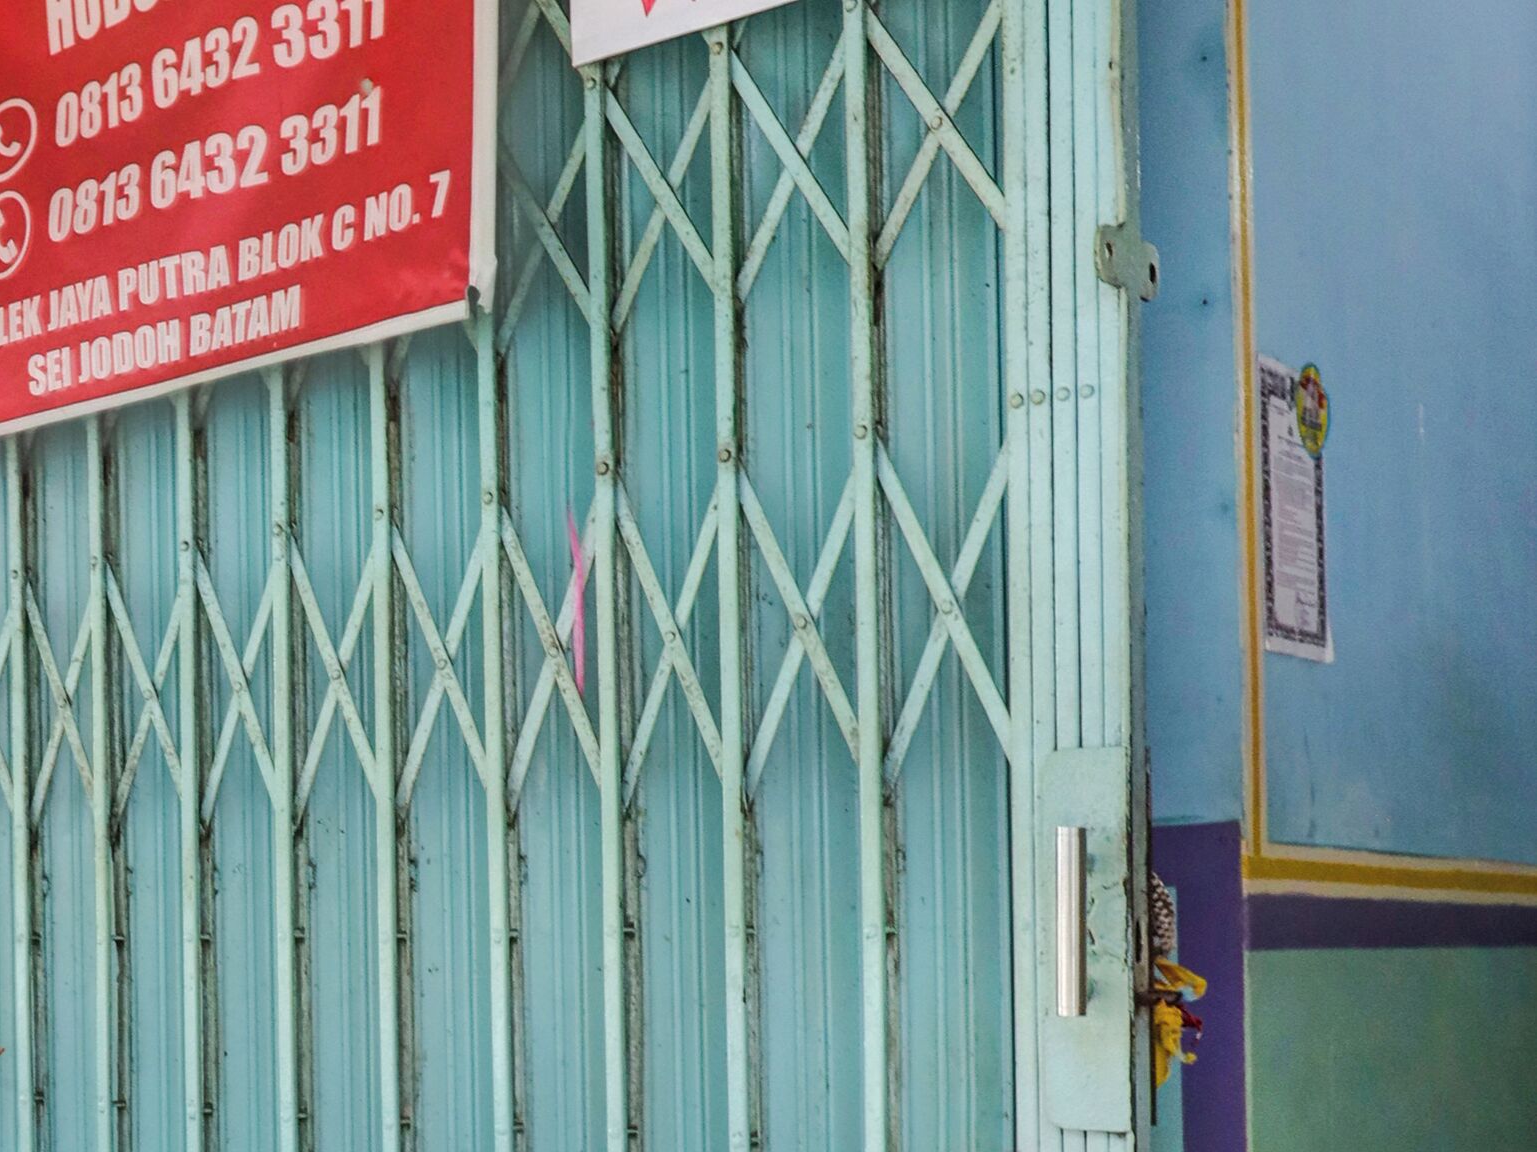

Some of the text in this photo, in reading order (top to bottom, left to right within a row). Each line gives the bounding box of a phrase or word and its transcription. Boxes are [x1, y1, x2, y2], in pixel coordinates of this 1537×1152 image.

[55, 0, 385, 147] 0813 6432 3311
[48, 86, 381, 242] 0813 6432 3311
[47, 275, 114, 332] JAYA
[117, 244, 231, 312] PUTRA
[237, 213, 324, 282] BLOK
[331, 204, 356, 251] C
[363, 183, 421, 241] NO.
[429, 169, 451, 218] 7
[27, 284, 301, 397] SEI JODOH BATAM
